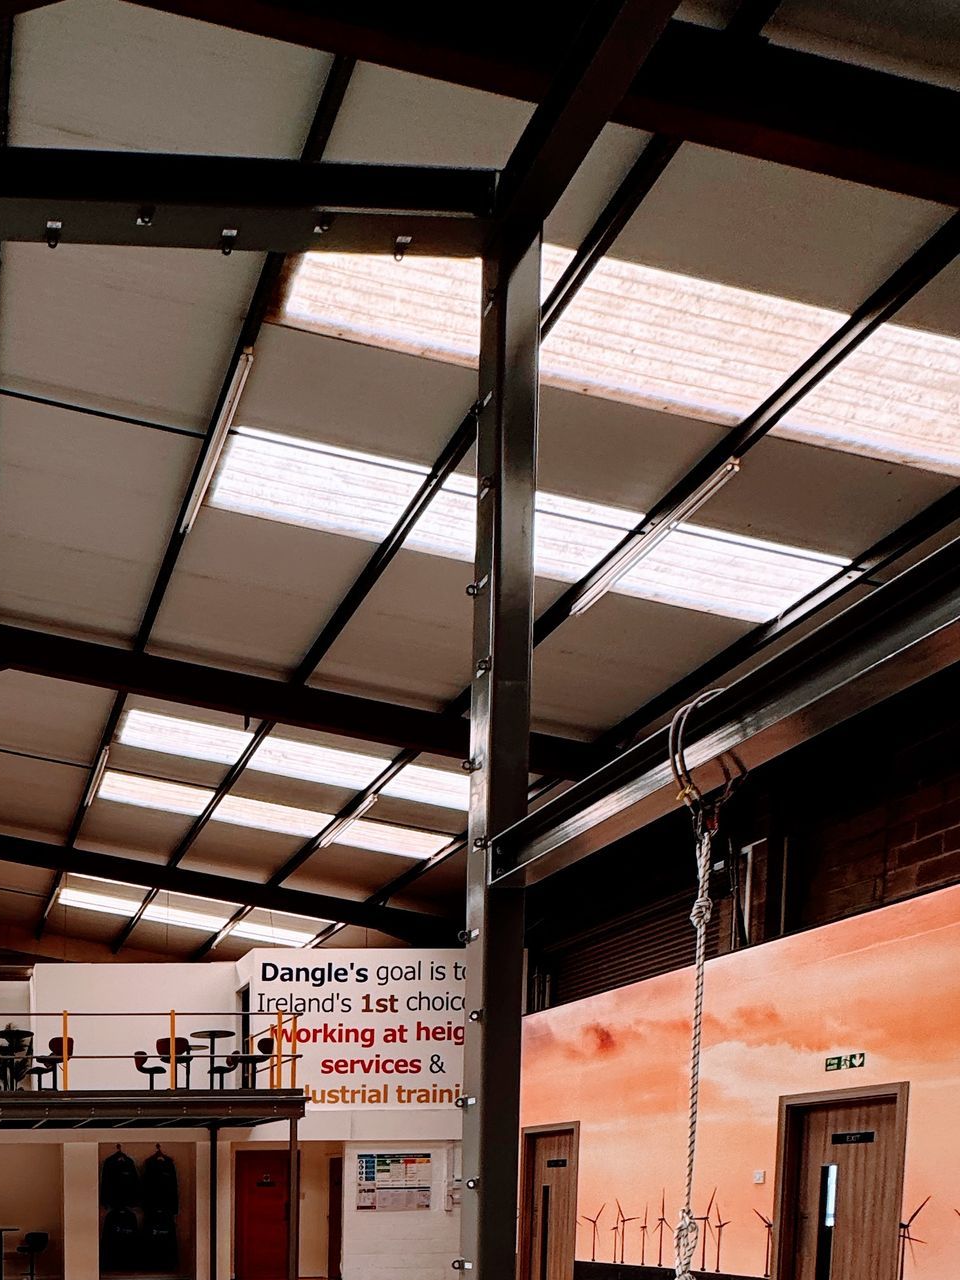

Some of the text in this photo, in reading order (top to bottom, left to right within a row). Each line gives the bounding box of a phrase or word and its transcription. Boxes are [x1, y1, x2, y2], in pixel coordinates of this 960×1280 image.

[261, 962, 369, 987] Dangle's
[376, 961, 421, 986] goal
[430, 961, 446, 981] is
[257, 991, 466, 1013] Ireland's 1st choic
[270, 1023, 375, 1047] working
[383, 1024, 408, 1043] at
[320, 1054, 446, 1074] services &
